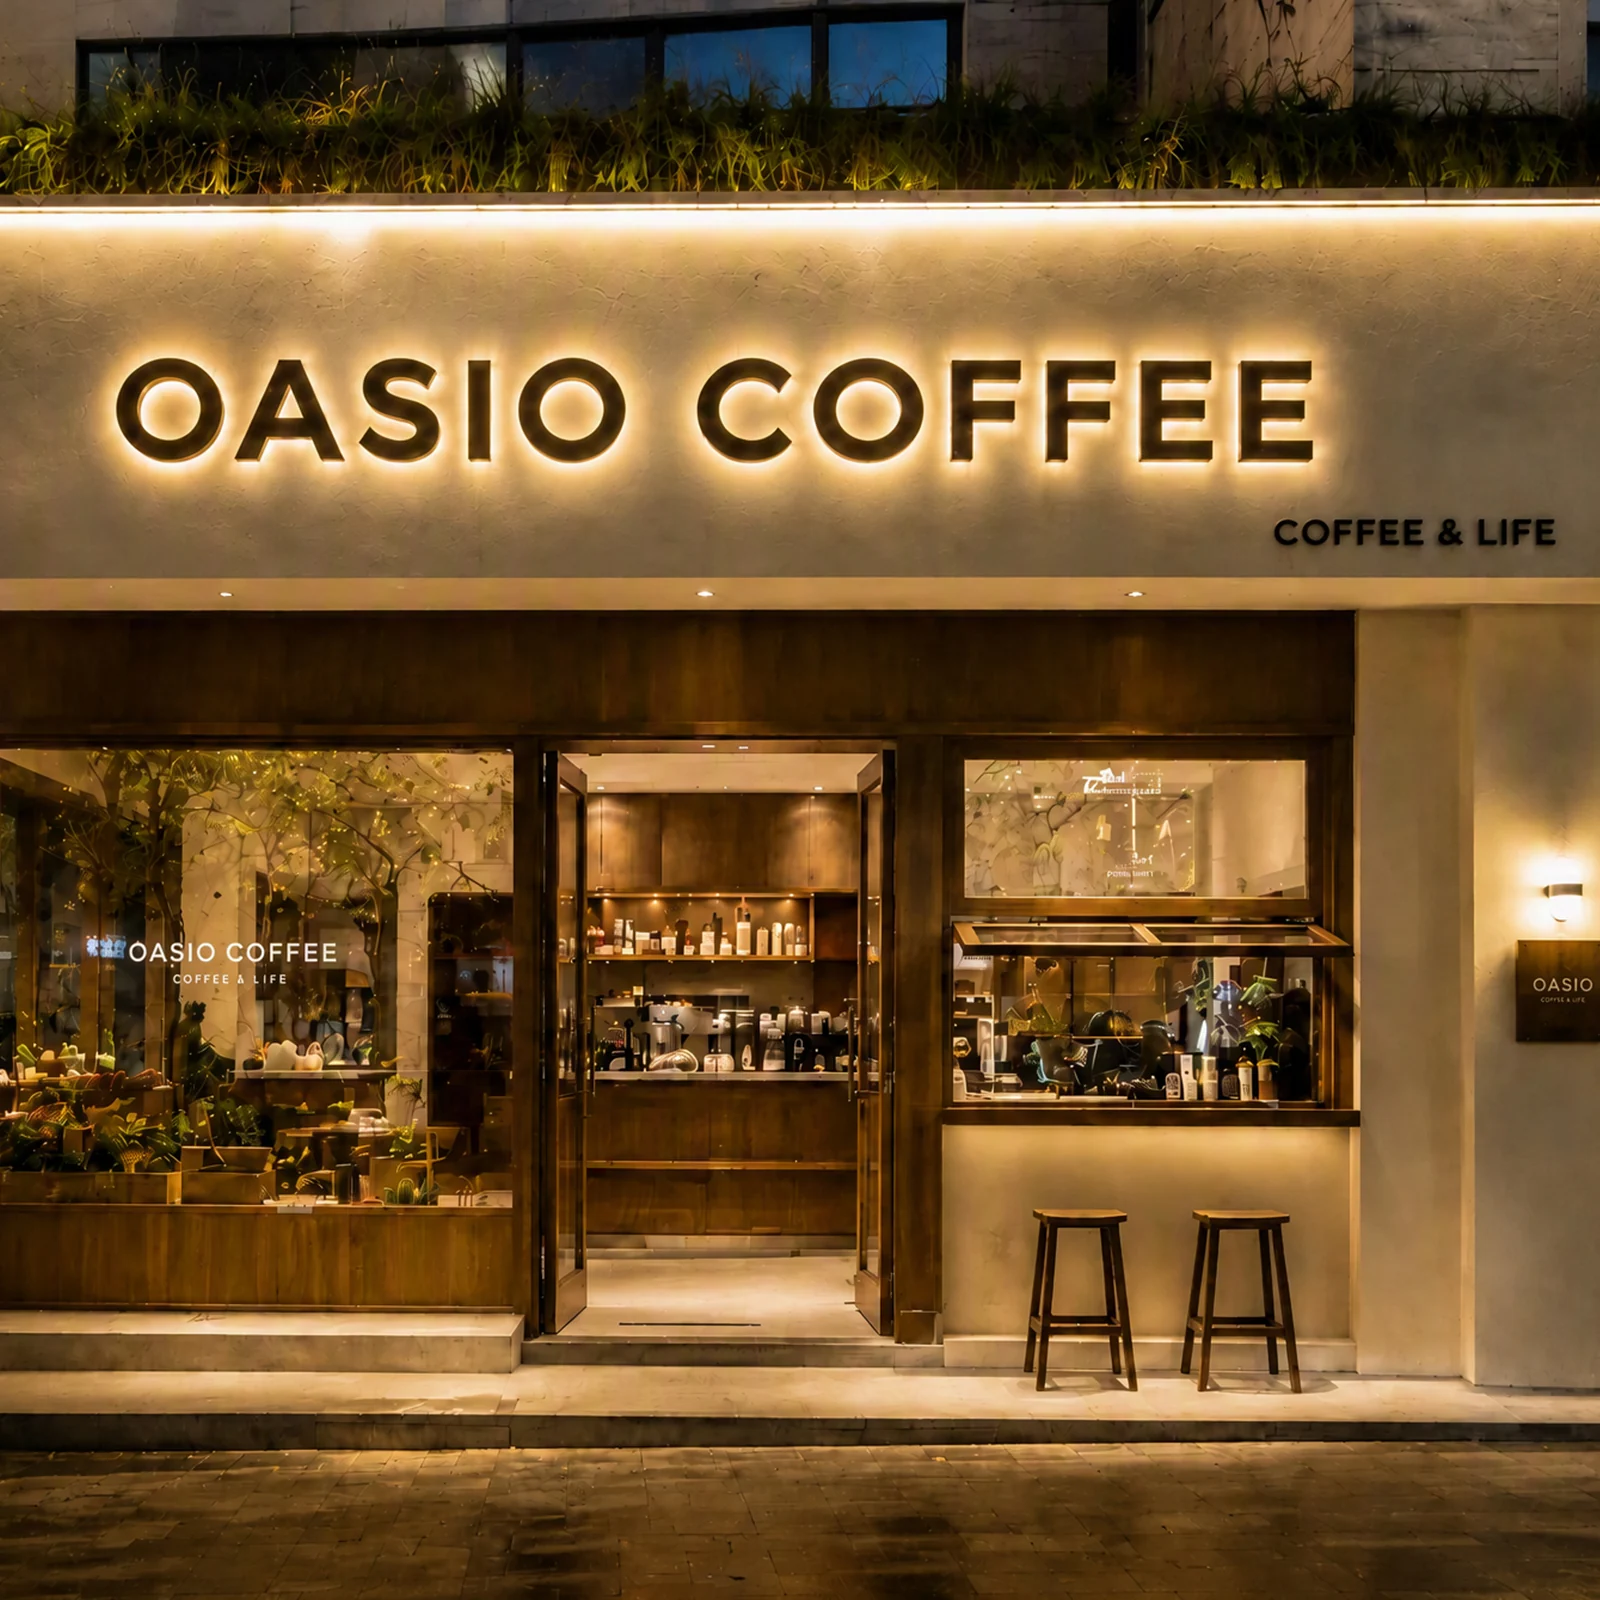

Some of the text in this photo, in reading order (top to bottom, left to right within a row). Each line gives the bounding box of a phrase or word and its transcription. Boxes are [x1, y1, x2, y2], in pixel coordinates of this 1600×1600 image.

[116, 357, 1313, 463] OASIO COFFEE
[1274, 518, 1556, 546] COFFEE & LIFE
[128, 942, 216, 963] OASIO
[226, 942, 337, 963] COFFEE
[172, 973, 230, 985] COFFEE
[253, 973, 287, 985] LIFE
[1533, 978, 1593, 992] OASIO
